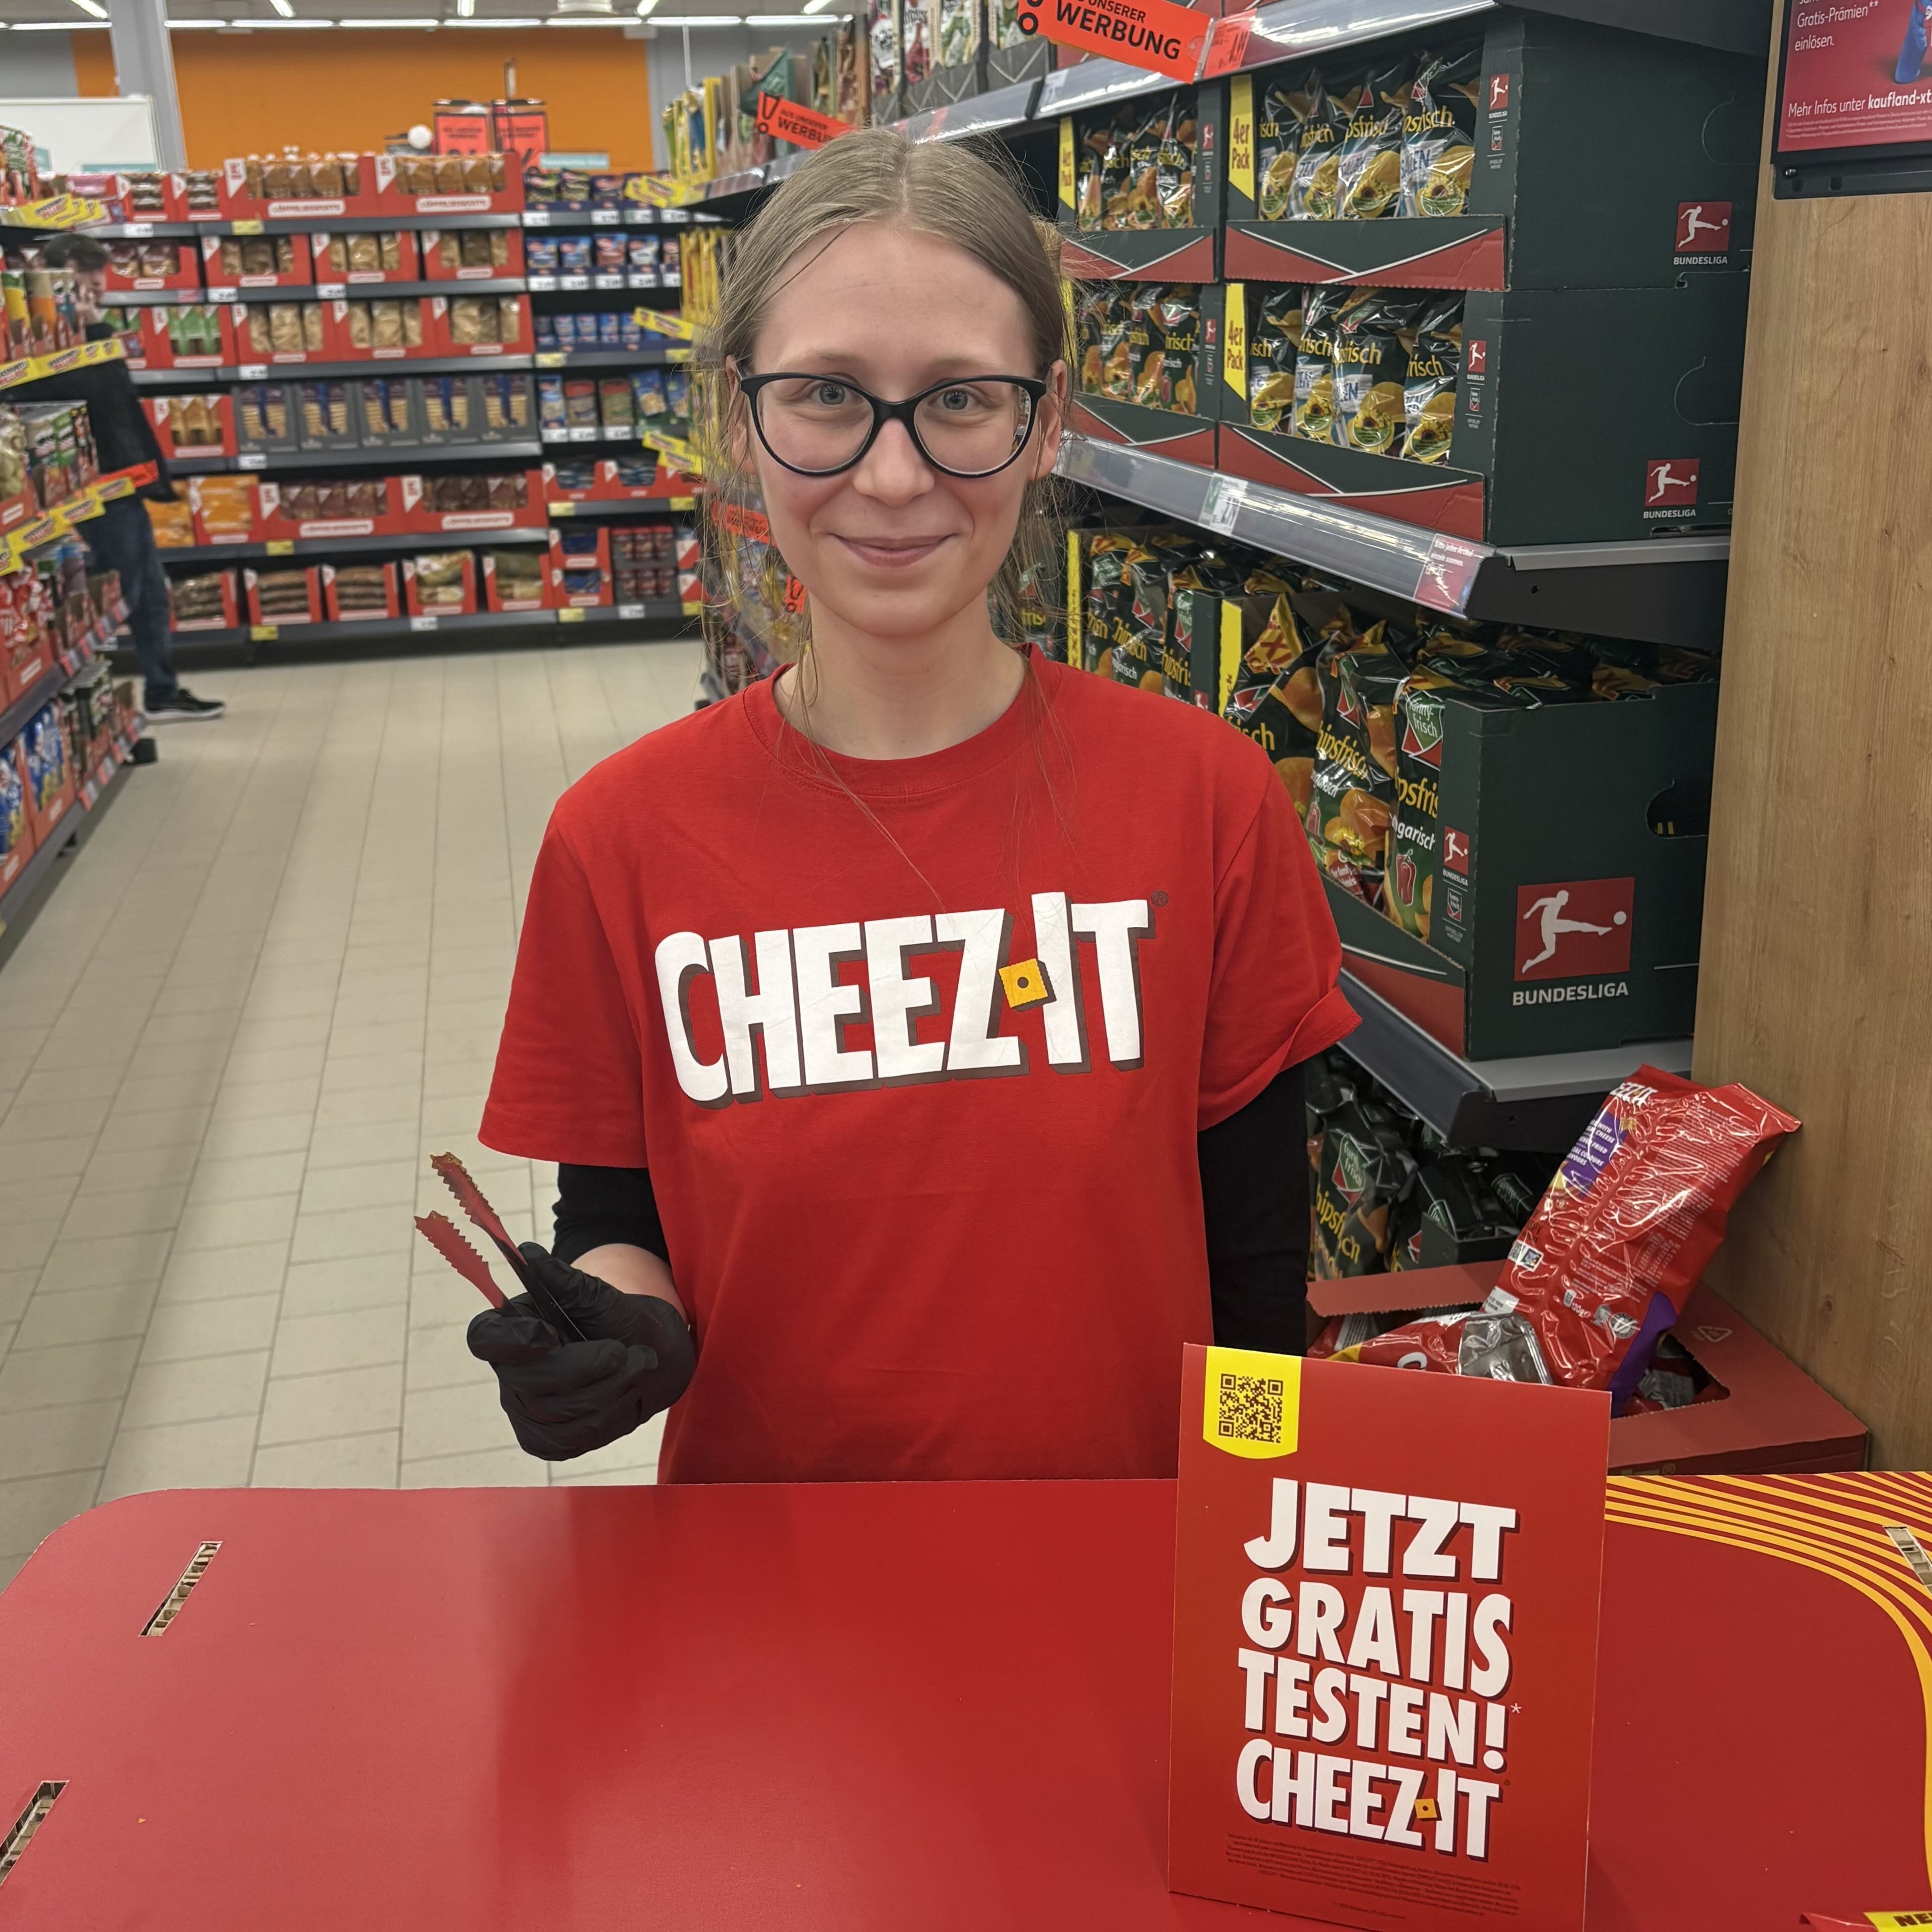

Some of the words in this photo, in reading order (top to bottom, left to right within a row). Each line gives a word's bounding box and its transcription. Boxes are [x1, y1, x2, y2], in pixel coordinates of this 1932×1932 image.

[1088, 0, 1146, 23] UNSERER
[1057, 0, 1181, 60] WERBUNG
[1795, 35, 1834, 51] einlösen.
[1788, 103, 1811, 118] Mehr
[1814, 99, 1837, 115] Infos
[1840, 98, 1866, 112] unter
[1868, 89, 1932, 110] kaufland-xt
[1234, 118, 1250, 145] 4er
[1232, 147, 1250, 169] Pack
[1673, 257, 1728, 265] BUNDESLIGA
[1228, 319, 1243, 347] 4er
[1227, 349, 1244, 371] Pack
[1643, 509, 1696, 519] BUNDESLIGA
[1413, 713, 1438, 738] frisch
[1443, 868, 1468, 886] BUNDESLIGA
[1513, 982, 1629, 1006] BUNDESLIGA
[1243, 1478, 1519, 1581] JETZT
[1241, 1577, 1513, 1698] GRATIS
[1893, 1912, 1932, 1927] NE
